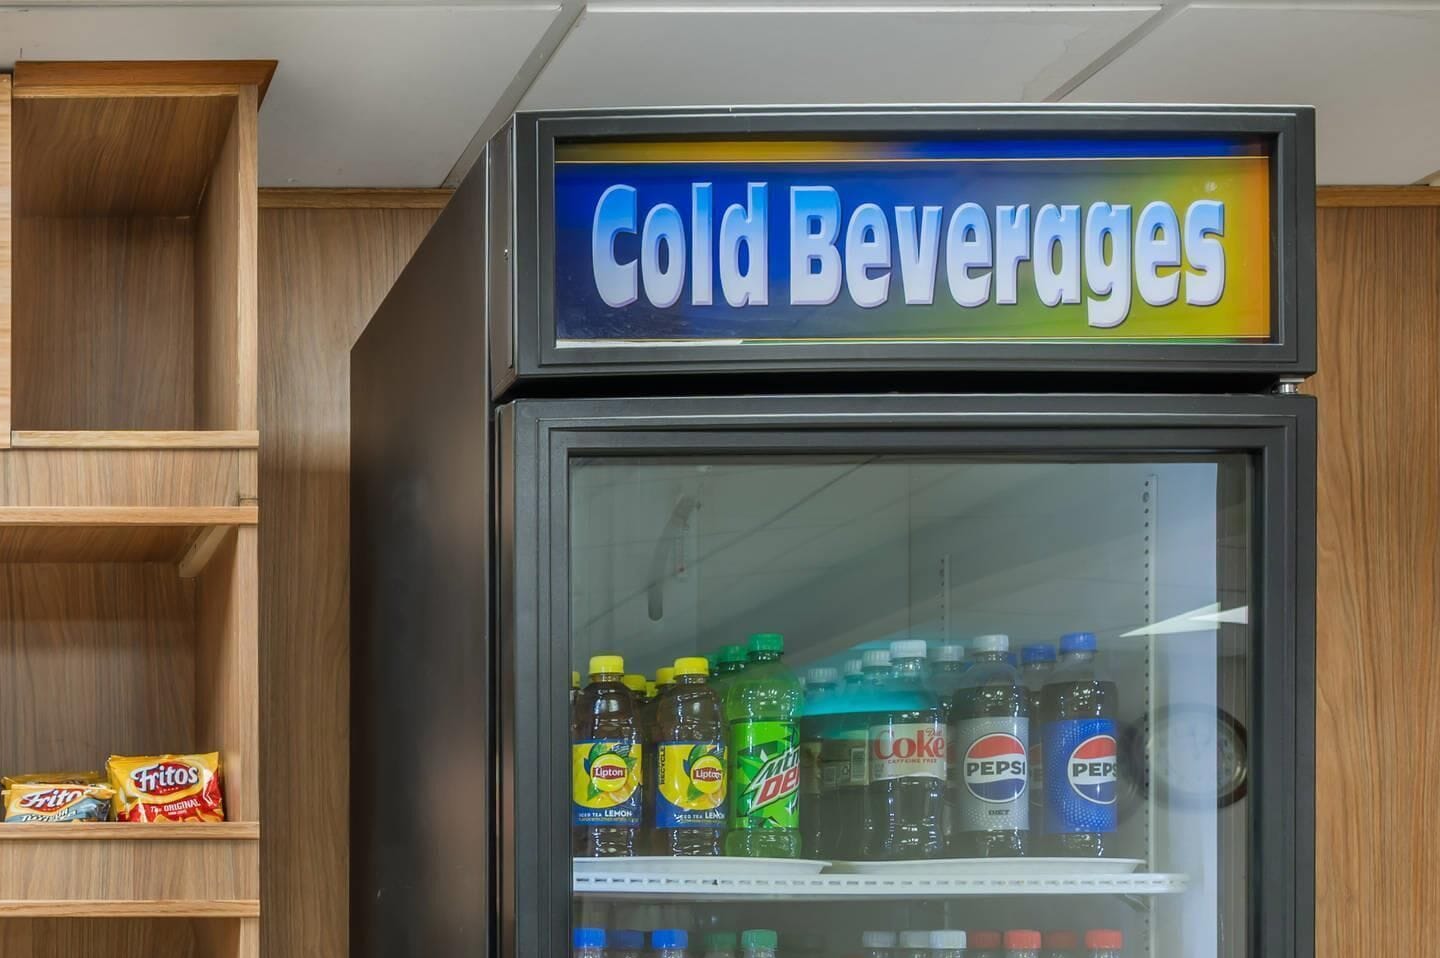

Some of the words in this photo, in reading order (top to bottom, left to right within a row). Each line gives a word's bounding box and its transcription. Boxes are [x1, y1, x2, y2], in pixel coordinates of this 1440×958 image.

[591, 182, 769, 309] Cold
[789, 185, 1226, 329] Beverages
[873, 729, 945, 760] Coke
[594, 766, 625, 778] Lipton
[966, 760, 1025, 777] PEPSI
[1072, 762, 1117, 777] PEPS
[130, 763, 199, 792] Fritos
[756, 765, 800, 806] De
[163, 798, 201, 812] ORIGINAL
[604, 809, 633, 818] LEMON
[705, 811, 725, 820] LEMO
